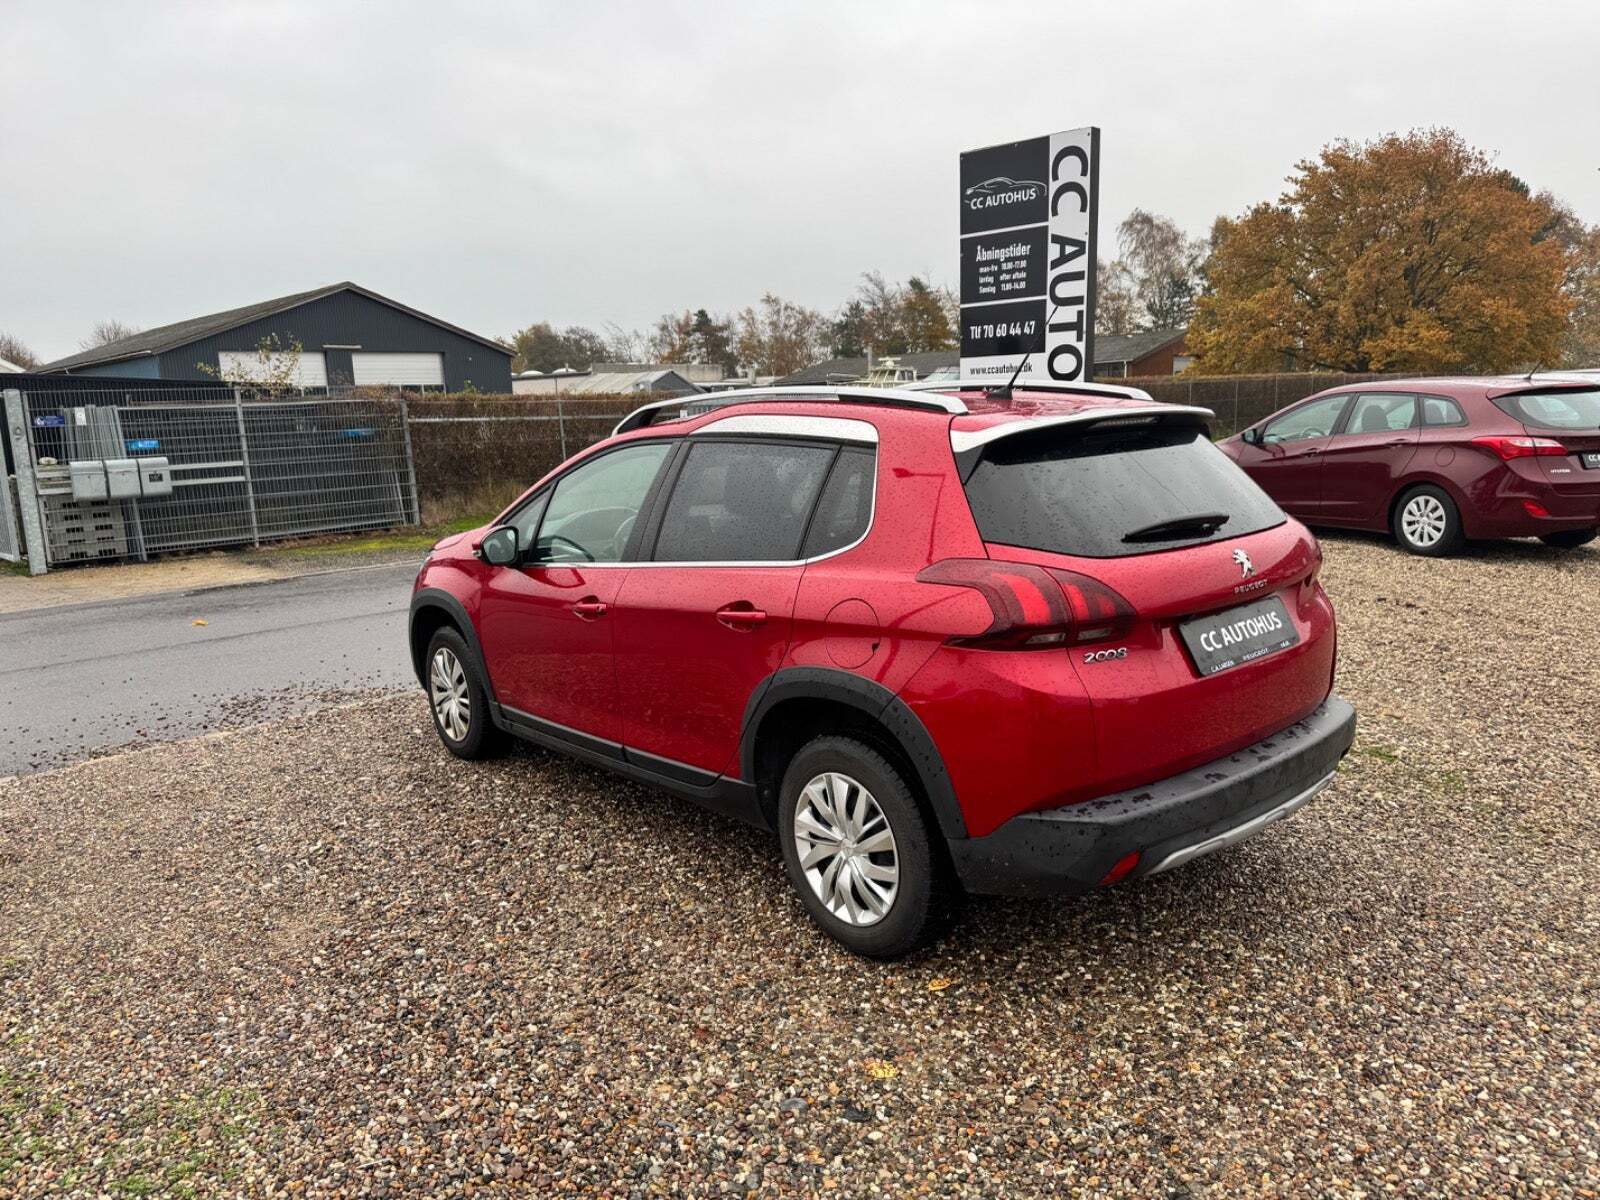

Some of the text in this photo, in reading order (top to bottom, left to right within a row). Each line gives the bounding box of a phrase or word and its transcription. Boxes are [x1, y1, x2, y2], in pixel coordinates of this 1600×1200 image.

[970, 188, 1036, 209] CC AUTOHUS
[976, 243, 1031, 262] Åbningstider
[1047, 145, 1089, 382] CC AUTO
[970, 320, 1035, 340] Tlf 70 60 44 47
[970, 362, 1033, 375] www.ccautohu.dk
[1200, 611, 1283, 652] CC AUTOHUS
[1083, 646, 1128, 664] 2008
